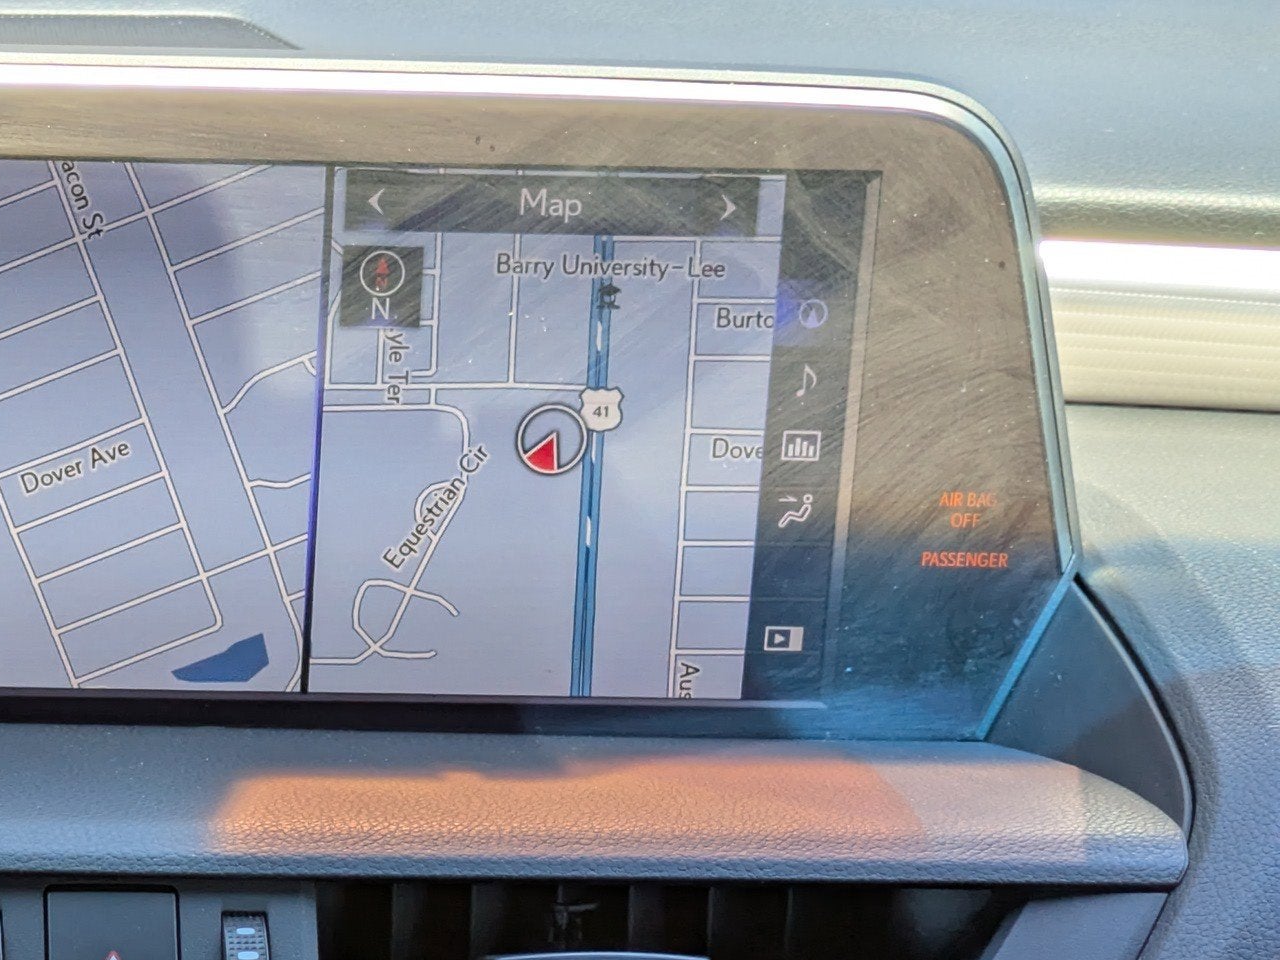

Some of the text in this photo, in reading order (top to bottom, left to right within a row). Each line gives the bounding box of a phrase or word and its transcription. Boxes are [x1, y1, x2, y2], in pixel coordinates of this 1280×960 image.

[520, 188, 582, 223] Map
[82, 213, 104, 239] St
[496, 252, 554, 279] Barry
[371, 297, 390, 320] N
[384, 328, 410, 404] yle Ter
[592, 405, 609, 418] 41
[20, 441, 131, 494] Dover Ave
[382, 445, 488, 569] Equestrian Cir
[939, 491, 998, 508] AIR BAG
[950, 512, 981, 528] OFF
[921, 551, 1009, 568] PASSENGER
